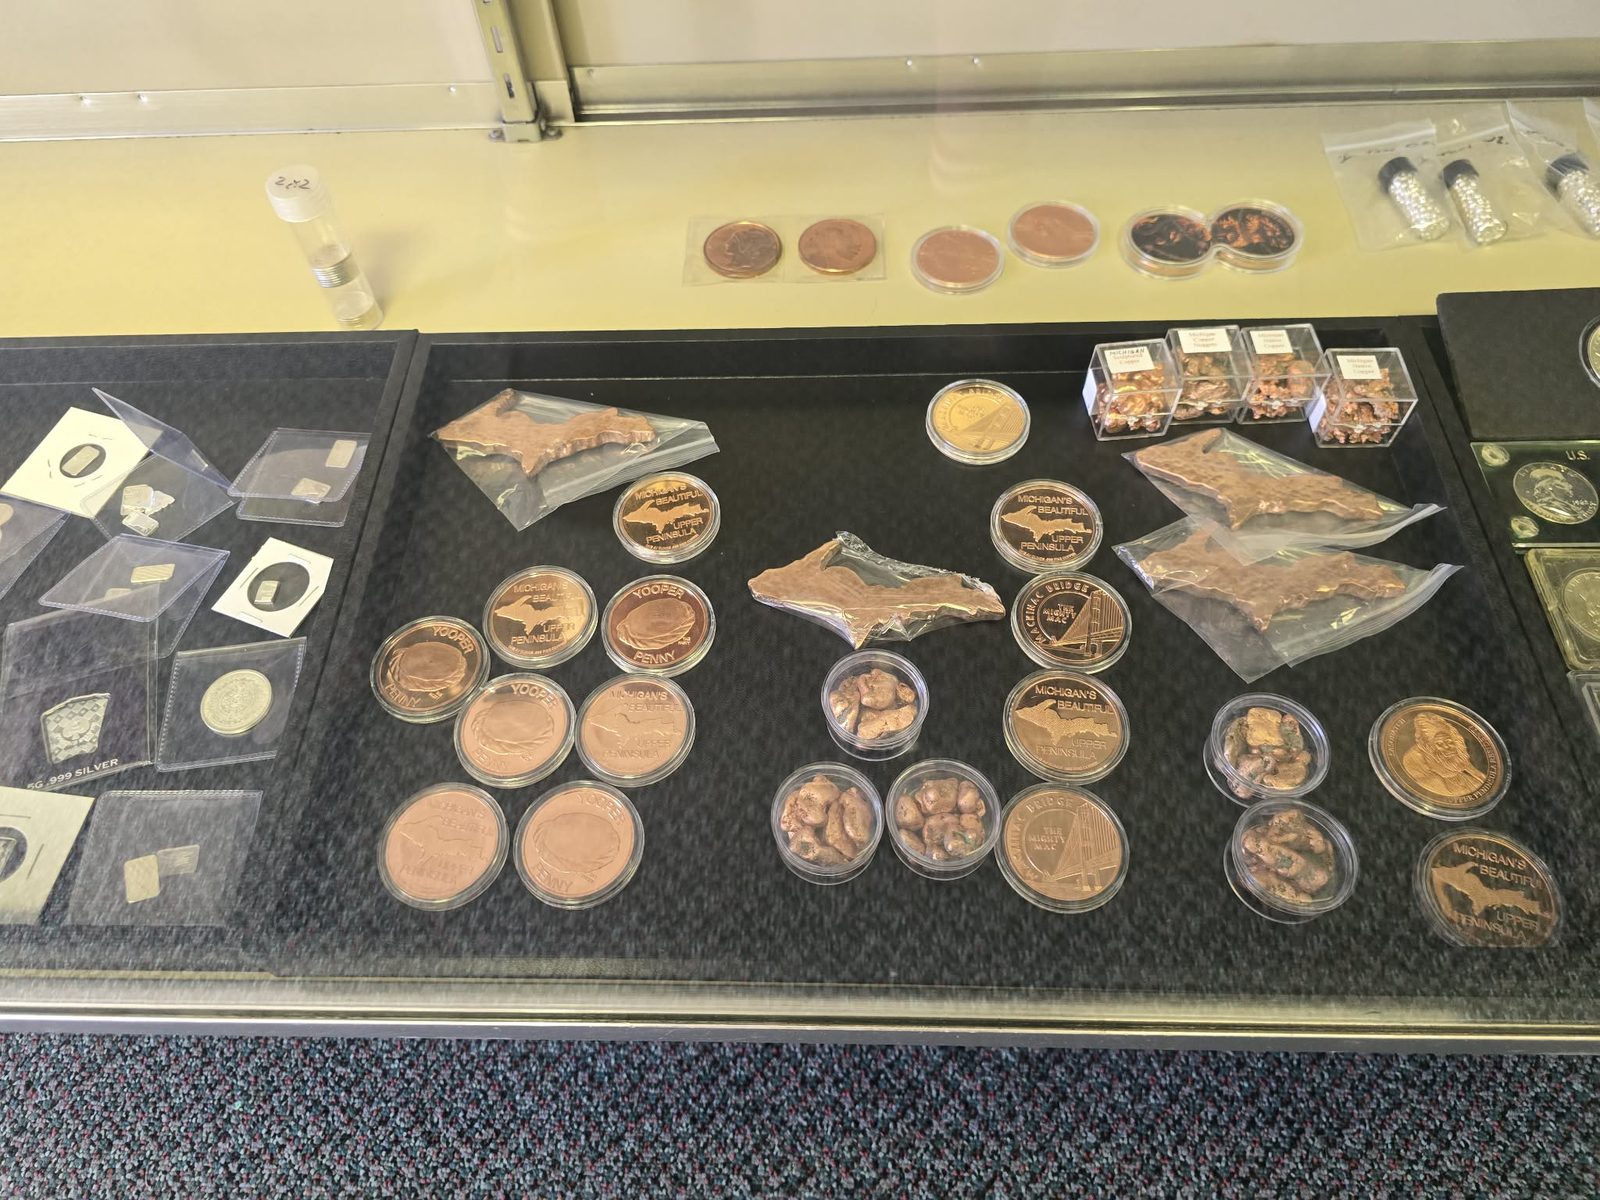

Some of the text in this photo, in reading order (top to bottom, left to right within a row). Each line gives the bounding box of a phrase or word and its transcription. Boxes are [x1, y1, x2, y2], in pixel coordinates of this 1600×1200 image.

[1565, 450, 1590, 460] U.S.
[635, 484, 687, 500] MICHIGAN'S
[655, 490, 704, 506] BEAUTIFUL
[1017, 495, 1073, 505] MICHIGAN'S
[1037, 506, 1089, 516] BEAUTIFUL
[673, 517, 704, 530] UPPER
[645, 528, 697, 544] PENINSULA
[1051, 535, 1084, 544] UPPER
[1020, 542, 1075, 552] PENINSULA
[513, 582, 568, 593] MICHIGAN'S
[632, 584, 686, 600] YOOPER
[1025, 580, 1090, 644] MACKINAC BRIDGE
[432, 627, 474, 654] YOOPER
[511, 633, 566, 645] PENINSULA
[633, 650, 676, 665] PENNY
[385, 683, 421, 708] PENNY
[609, 690, 668, 702] MICHIGAN'S
[1035, 685, 1097, 700] MICHIGAN'S
[1057, 700, 1115, 715] BEAUTIFUL
[1036, 744, 1097, 760] PENINSULA
[1072, 739, 1108, 750] UPPER
[27, 758, 119, 790] 5G .999 SILVER
[1453, 842, 1526, 870] MICHIGAN'S
[1497, 911, 1538, 930] UPPER
